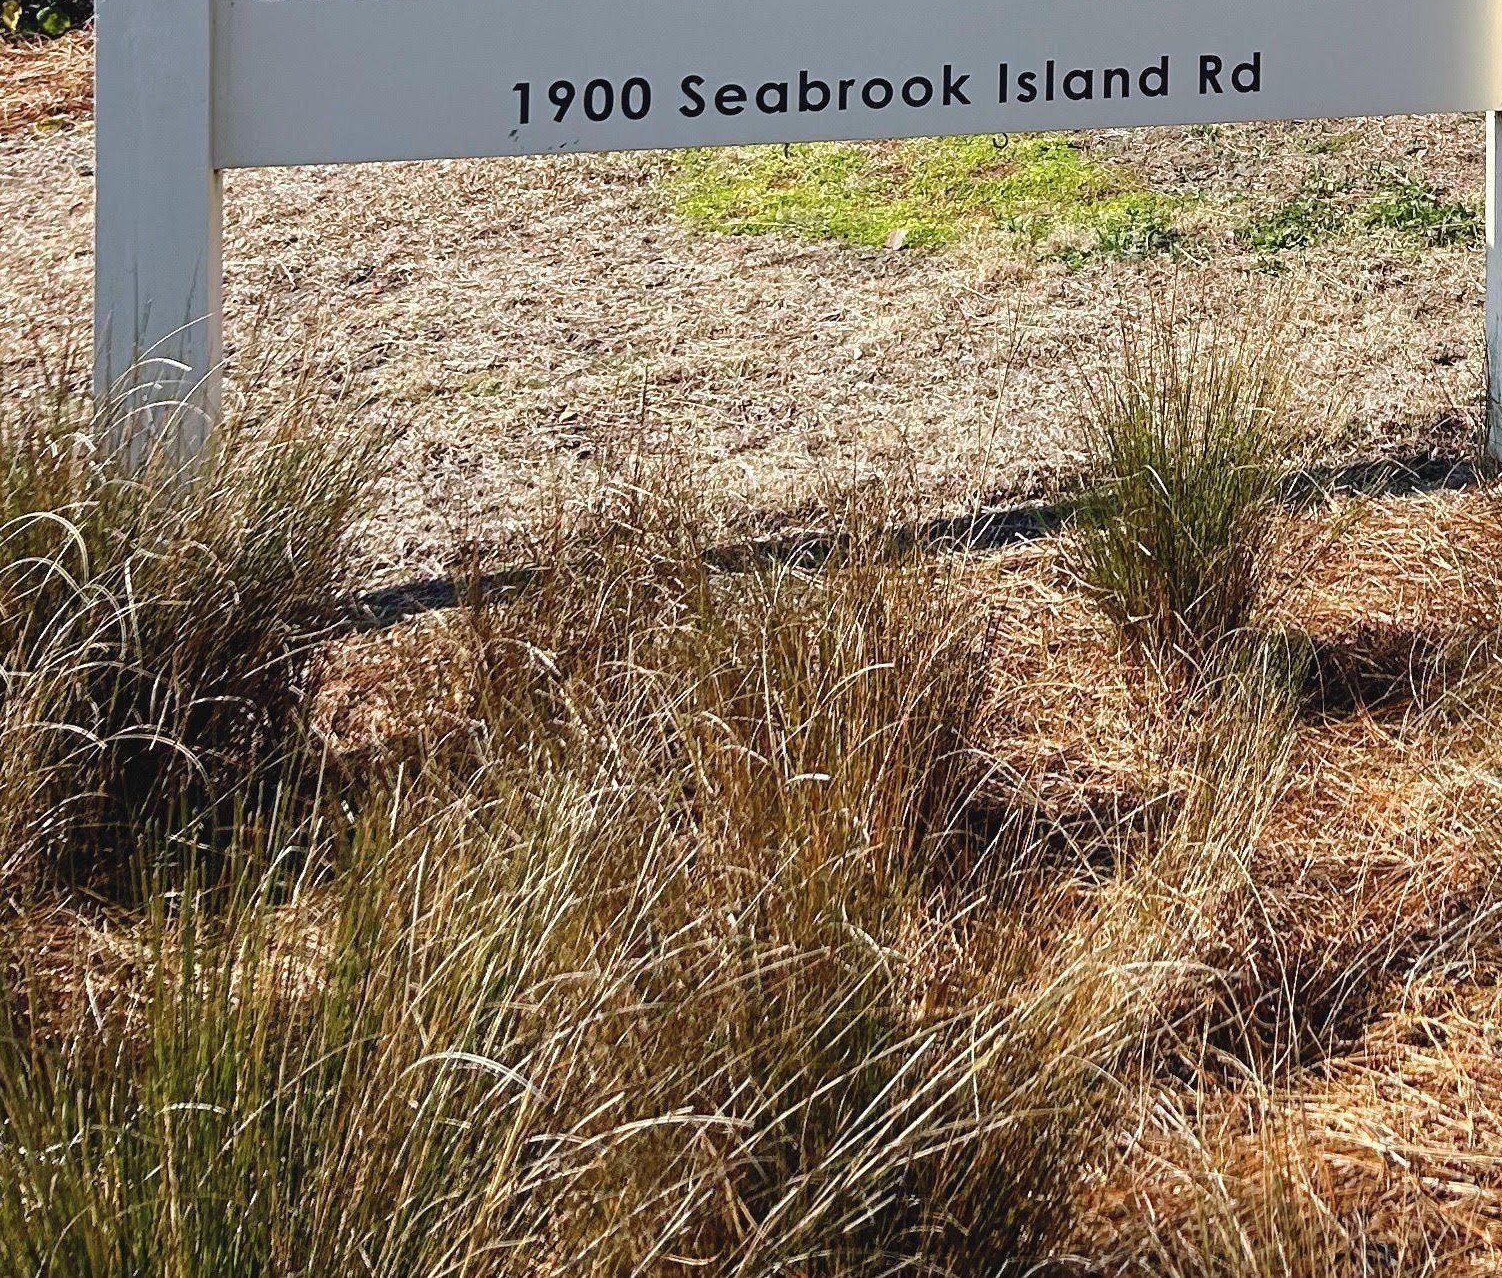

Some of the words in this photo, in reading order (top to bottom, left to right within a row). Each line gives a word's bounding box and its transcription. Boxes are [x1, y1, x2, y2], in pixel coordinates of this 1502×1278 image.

[512, 76, 652, 125] 1900
[678, 64, 972, 118] Seabrook
[998, 55, 1170, 104] Island
[1199, 51, 1261, 95] Rd
